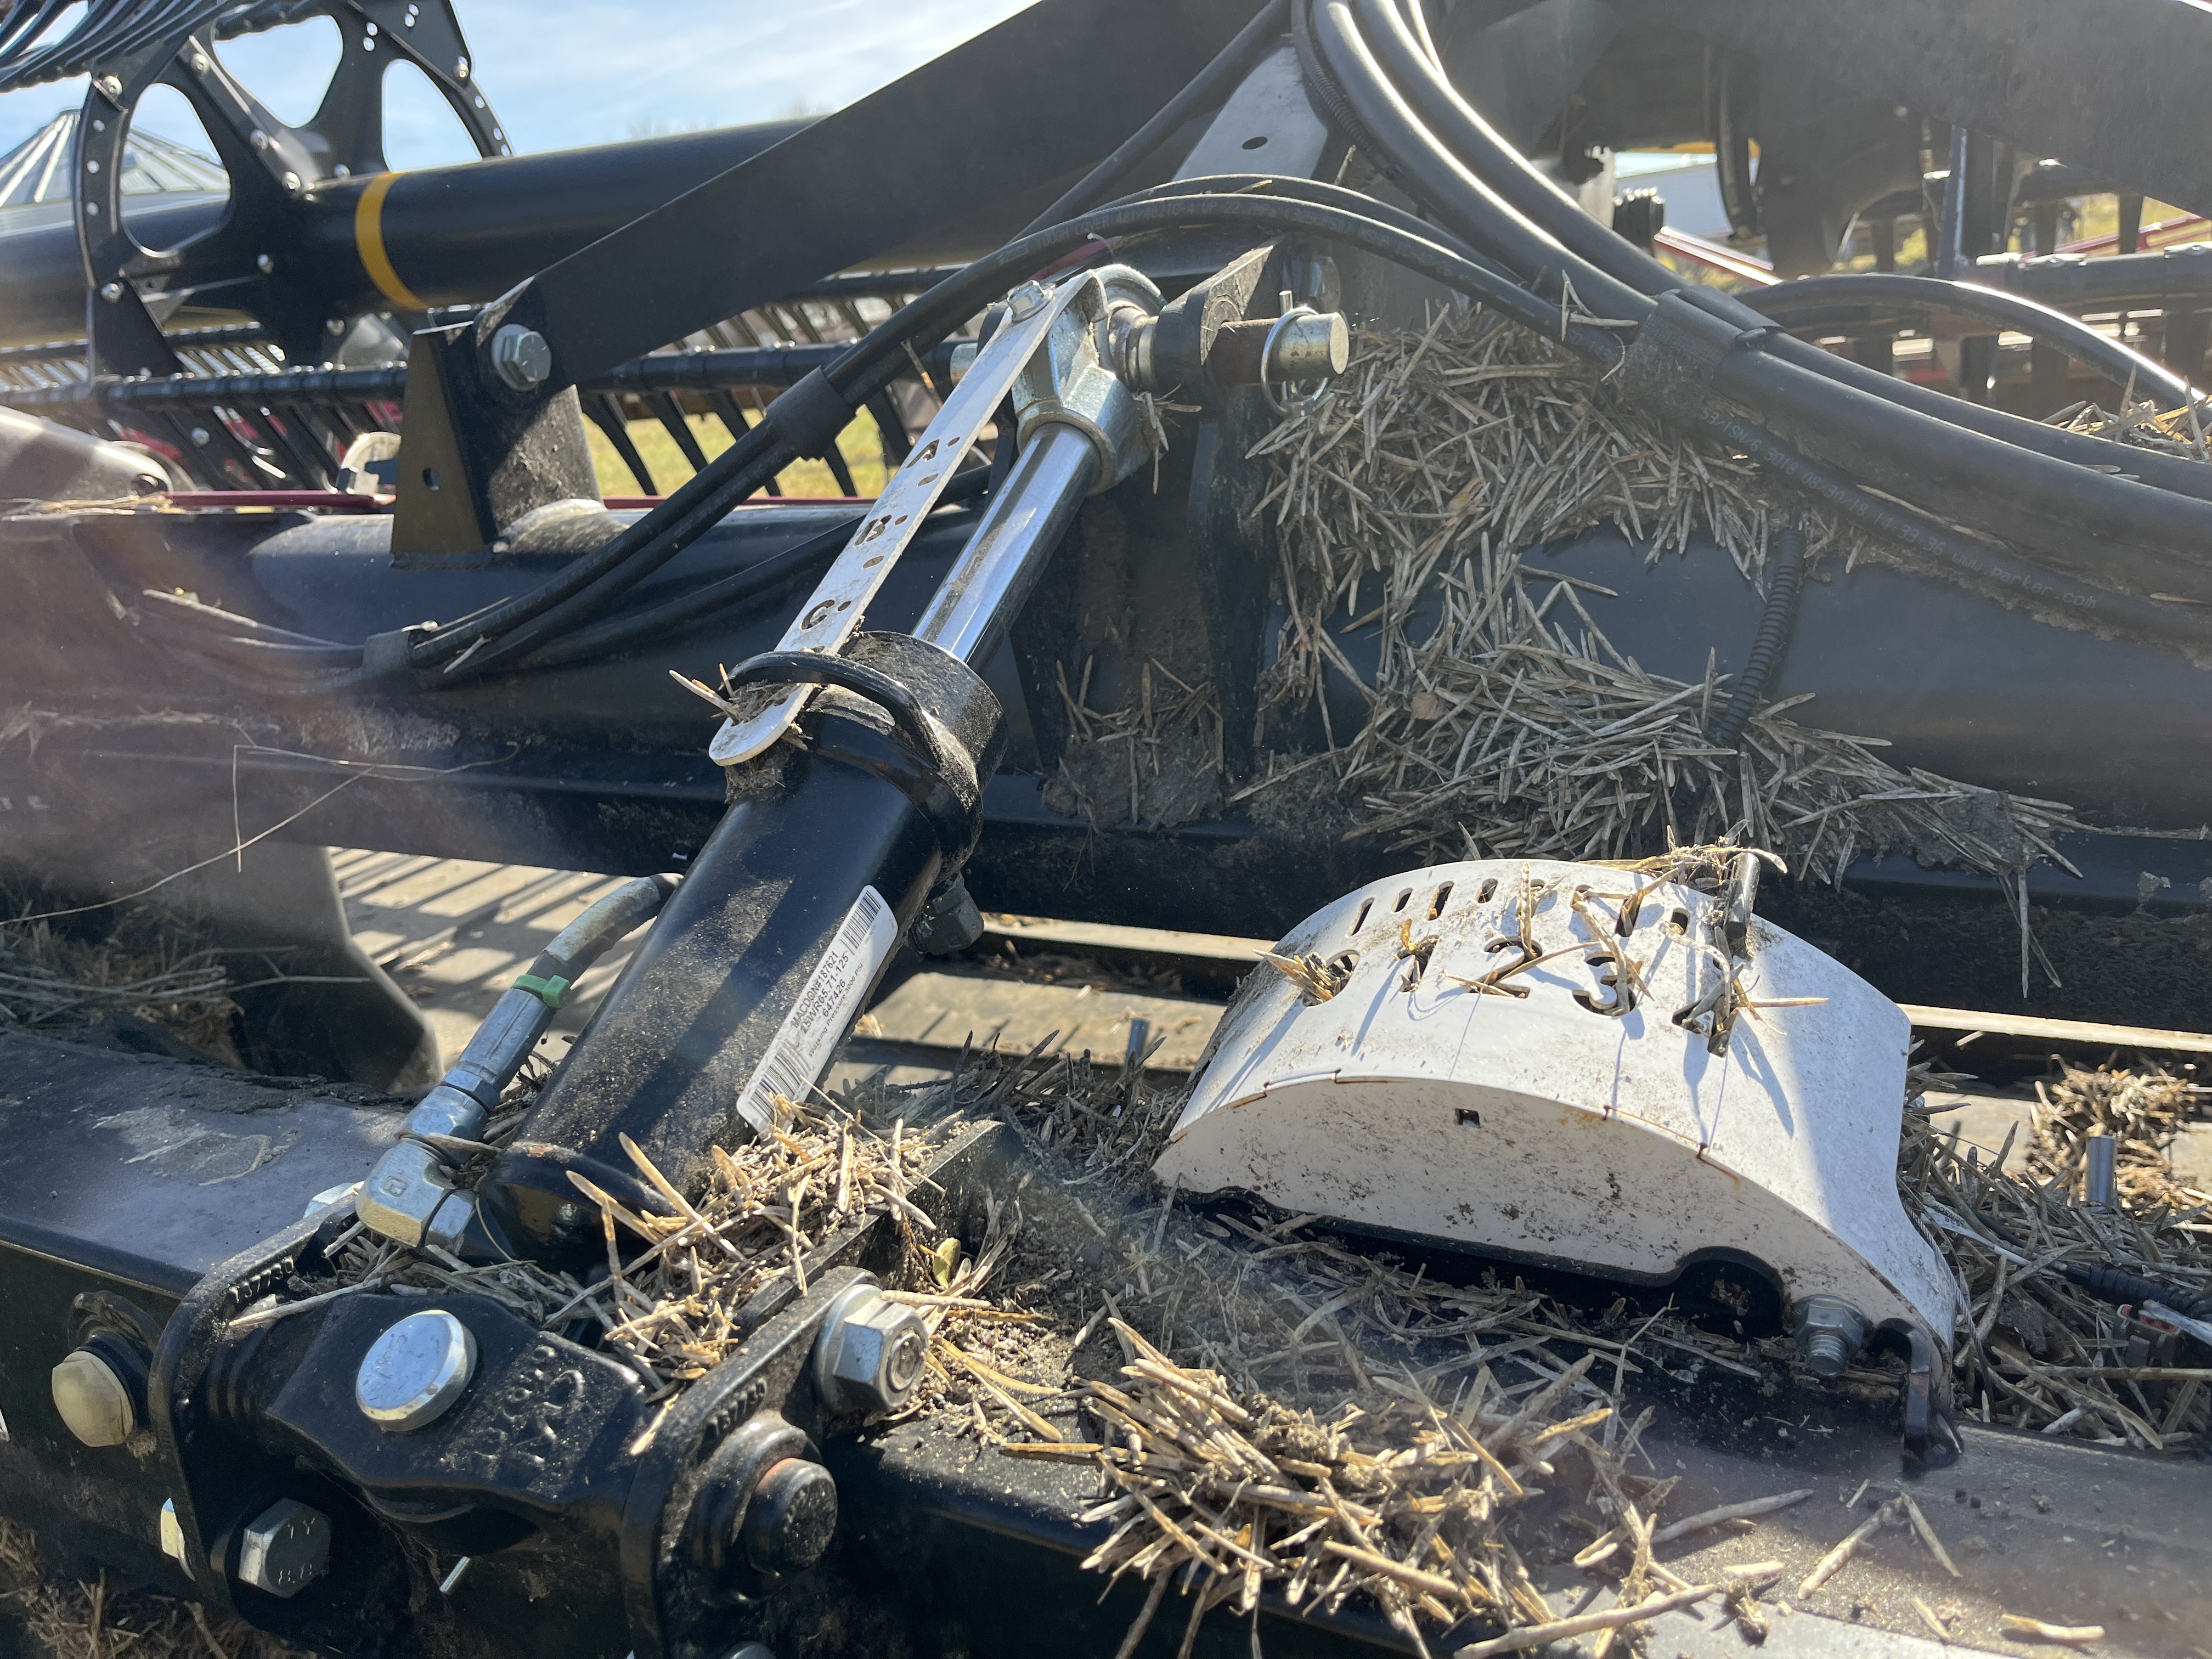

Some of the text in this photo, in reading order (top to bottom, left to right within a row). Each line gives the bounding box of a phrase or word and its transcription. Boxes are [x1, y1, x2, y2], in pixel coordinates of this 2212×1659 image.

[1763, 447, 1800, 476] 3018
[854, 515, 892, 546] B
[1468, 936, 1543, 998] 2
[823, 979, 845, 1017] 647426
[827, 994, 845, 1026] Pressure
[855, 962, 863, 976] PSI
